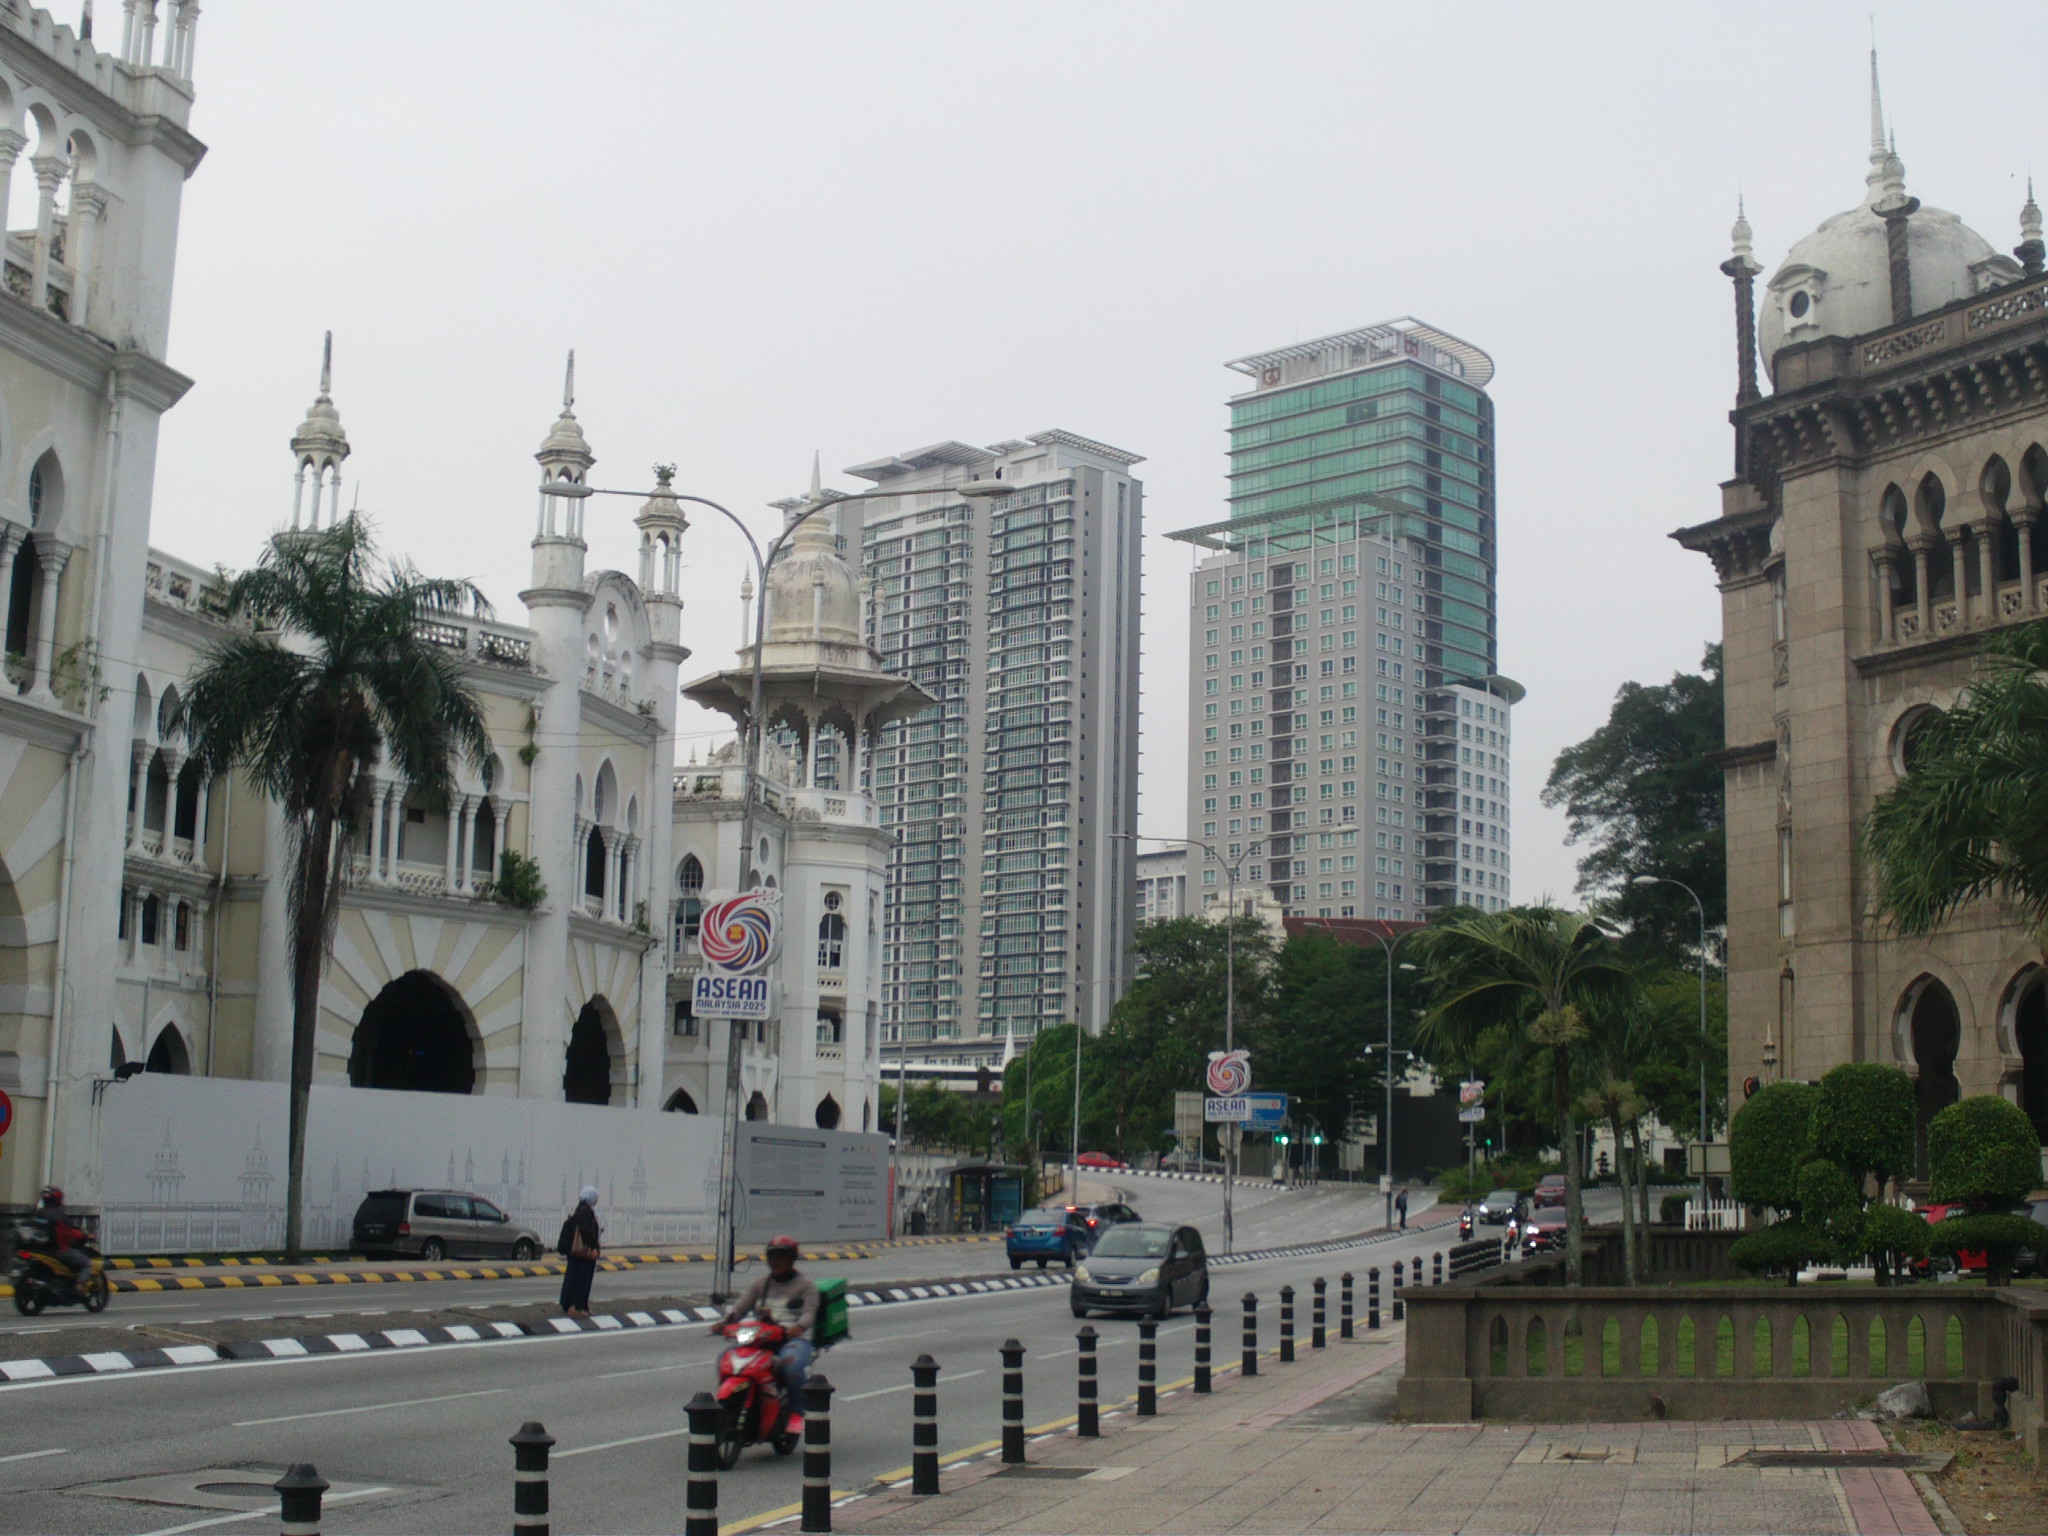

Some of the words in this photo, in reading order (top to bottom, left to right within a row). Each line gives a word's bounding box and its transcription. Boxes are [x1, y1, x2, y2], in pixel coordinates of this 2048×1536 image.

[697, 977, 767, 1000] ASEAN
[695, 1000, 740, 1010] MALAYSIA
[743, 1001, 766, 1011] 2025
[1208, 1100, 1246, 1111] ASEAN
